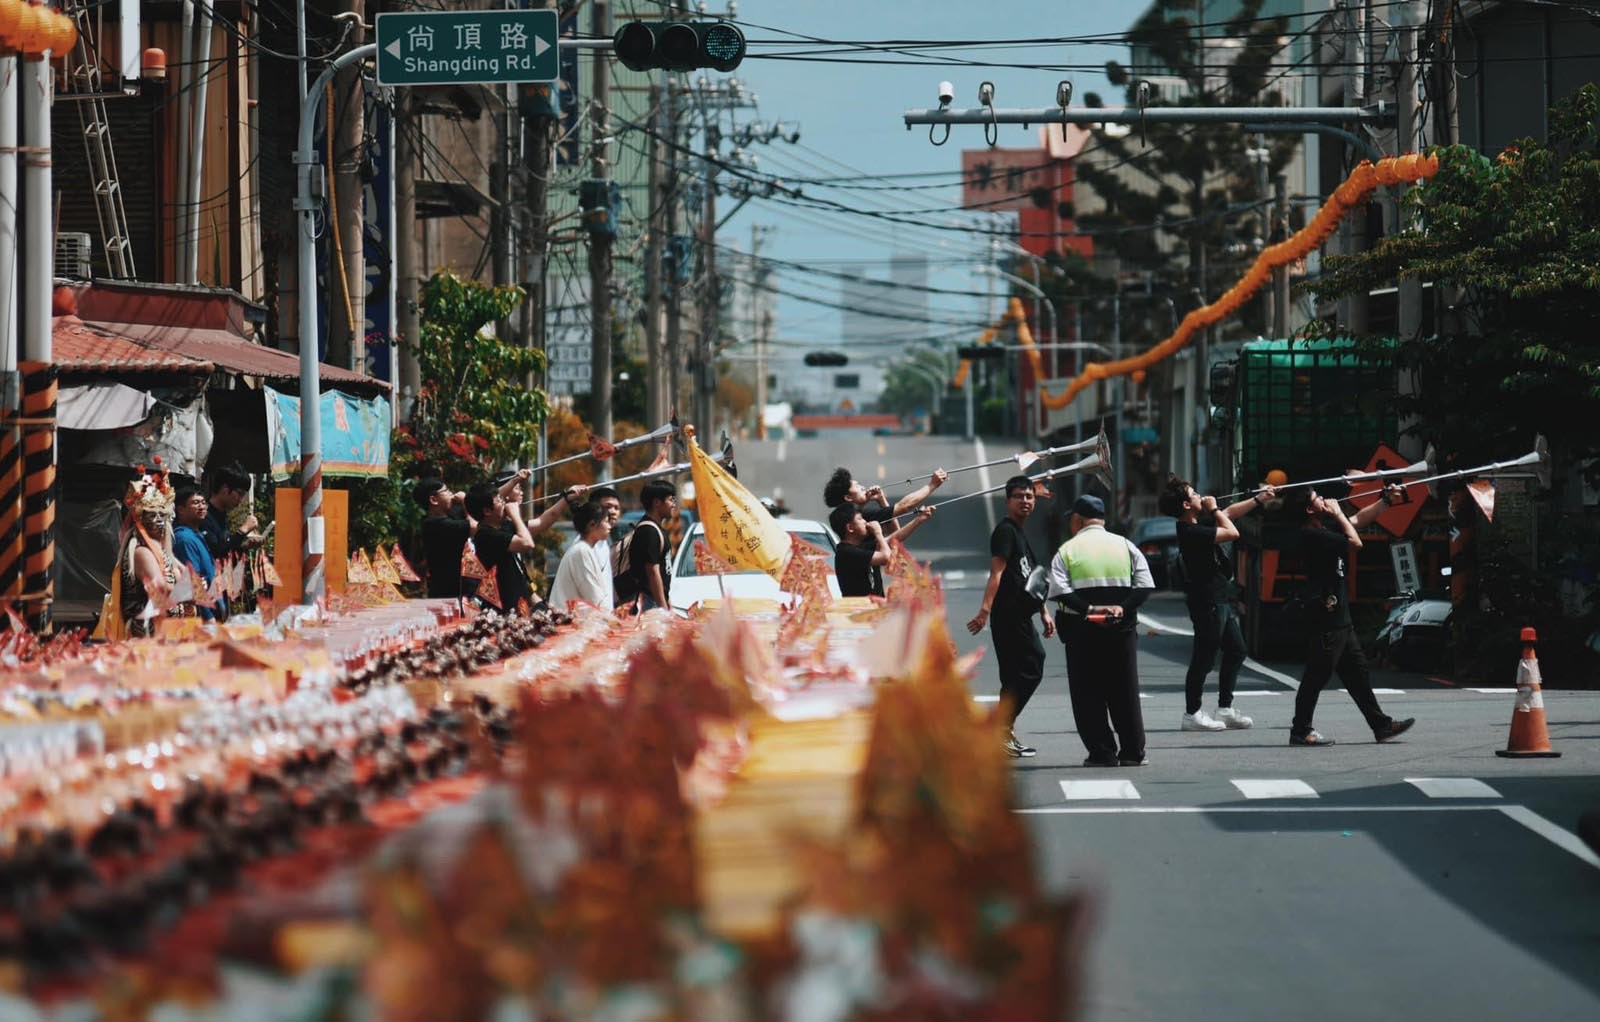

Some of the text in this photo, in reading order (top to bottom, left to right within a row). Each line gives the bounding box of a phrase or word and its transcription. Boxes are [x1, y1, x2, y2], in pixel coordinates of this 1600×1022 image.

[407, 22, 528, 52] 尚頂路
[404, 54, 536, 76] Shangding Rd.
